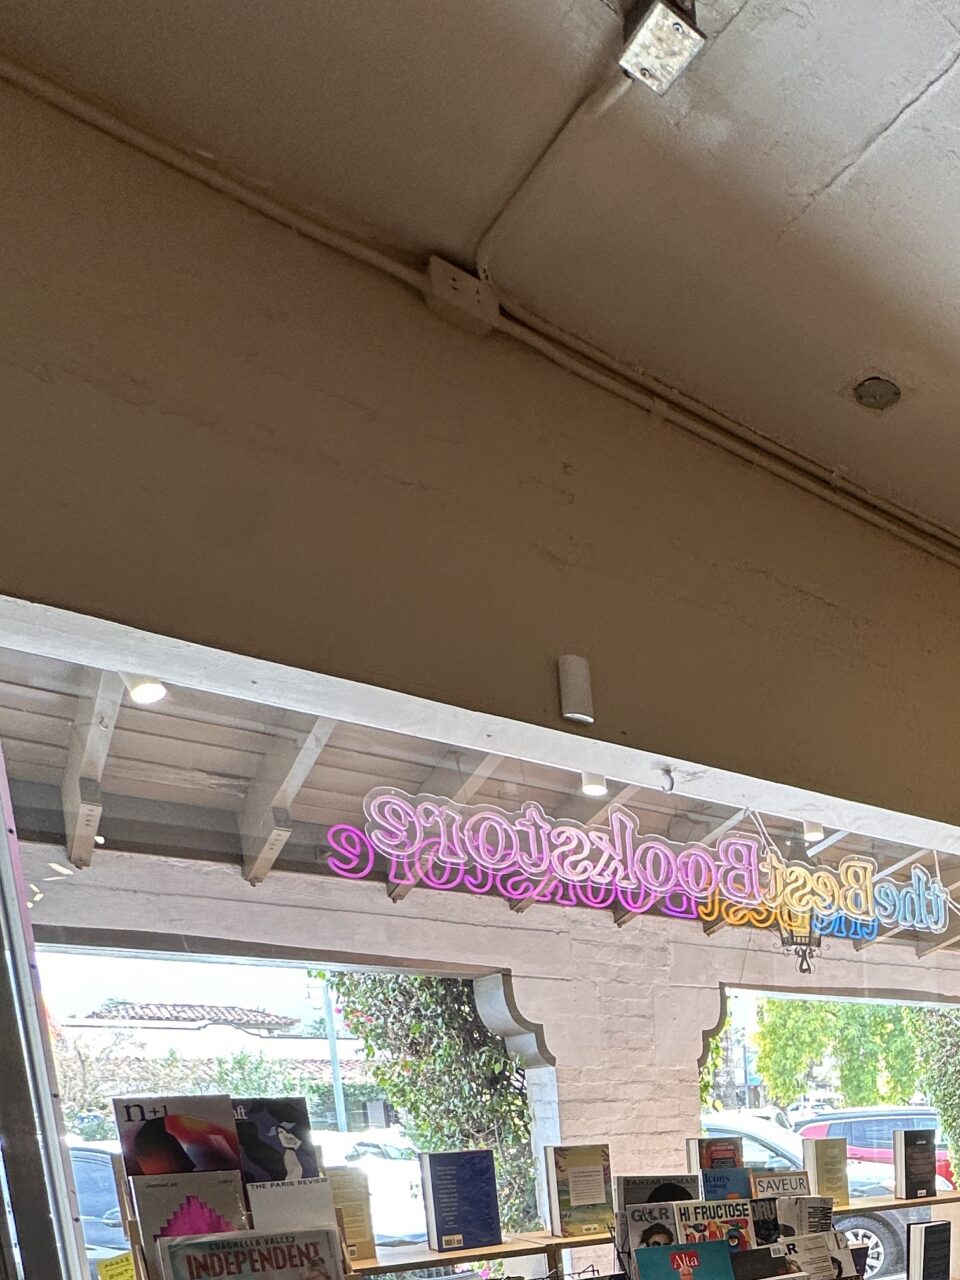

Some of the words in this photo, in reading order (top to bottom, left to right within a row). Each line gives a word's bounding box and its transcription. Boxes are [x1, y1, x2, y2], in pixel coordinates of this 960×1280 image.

[123, 1103, 168, 1122] n+1
[270, 1180, 295, 1188] PARIS
[297, 1177, 329, 1186] REVIEW
[703, 1173, 730, 1184] Icons
[757, 1177, 807, 1193] SAVEUR
[209, 1238, 261, 1251] COACHELLA
[263, 1235, 296, 1245] VALLEY
[185, 1241, 321, 1280] INDEPENDENT
[672, 1251, 699, 1268] Alta
